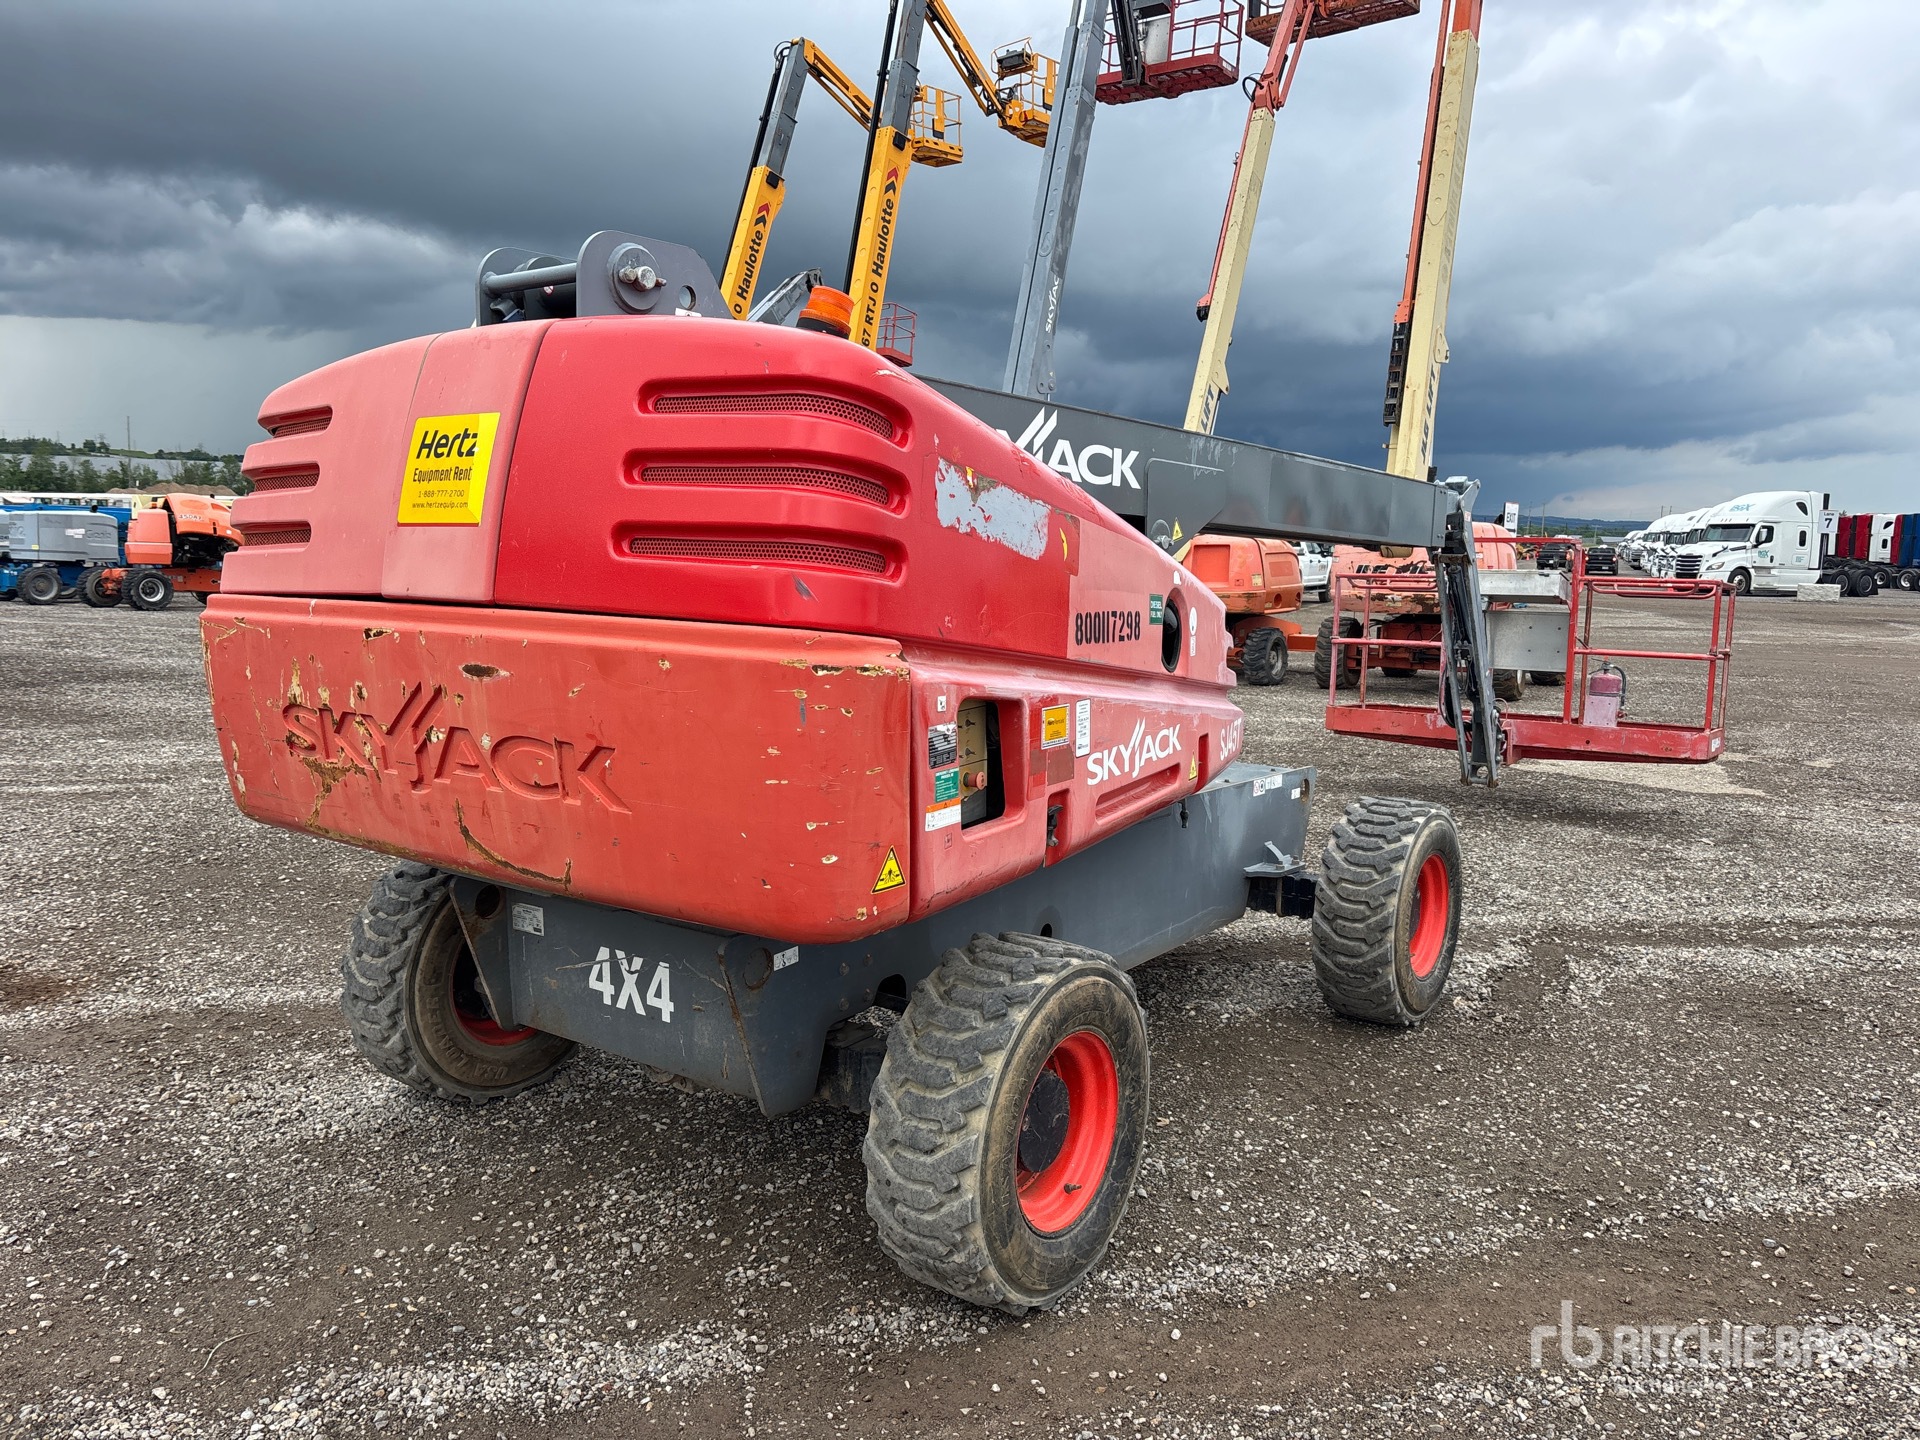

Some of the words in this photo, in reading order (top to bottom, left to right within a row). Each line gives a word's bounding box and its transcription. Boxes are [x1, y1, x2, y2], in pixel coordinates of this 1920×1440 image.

[737, 230, 763, 301] Haulotte
[864, 297, 877, 326] RTJ
[872, 198, 894, 278] Haulotte
[1045, 275, 1060, 333] SKYJAC
[1201, 383, 1214, 433] LIFT
[1426, 364, 1436, 418] LIFT
[416, 428, 478, 459] Hertz
[412, 467, 453, 484] Equipment
[418, 489, 465, 498] 1-888-777-2700
[411, 501, 468, 510] www.hertzequip.com
[1506, 512, 1517, 523] EXIT
[1824, 517, 1833, 529] 7
[1075, 610, 1141, 646] 800117298
[282, 681, 633, 815] SKYJACK
[1086, 718, 1182, 786] SKYJACK
[588, 946, 675, 1024] 4X4
